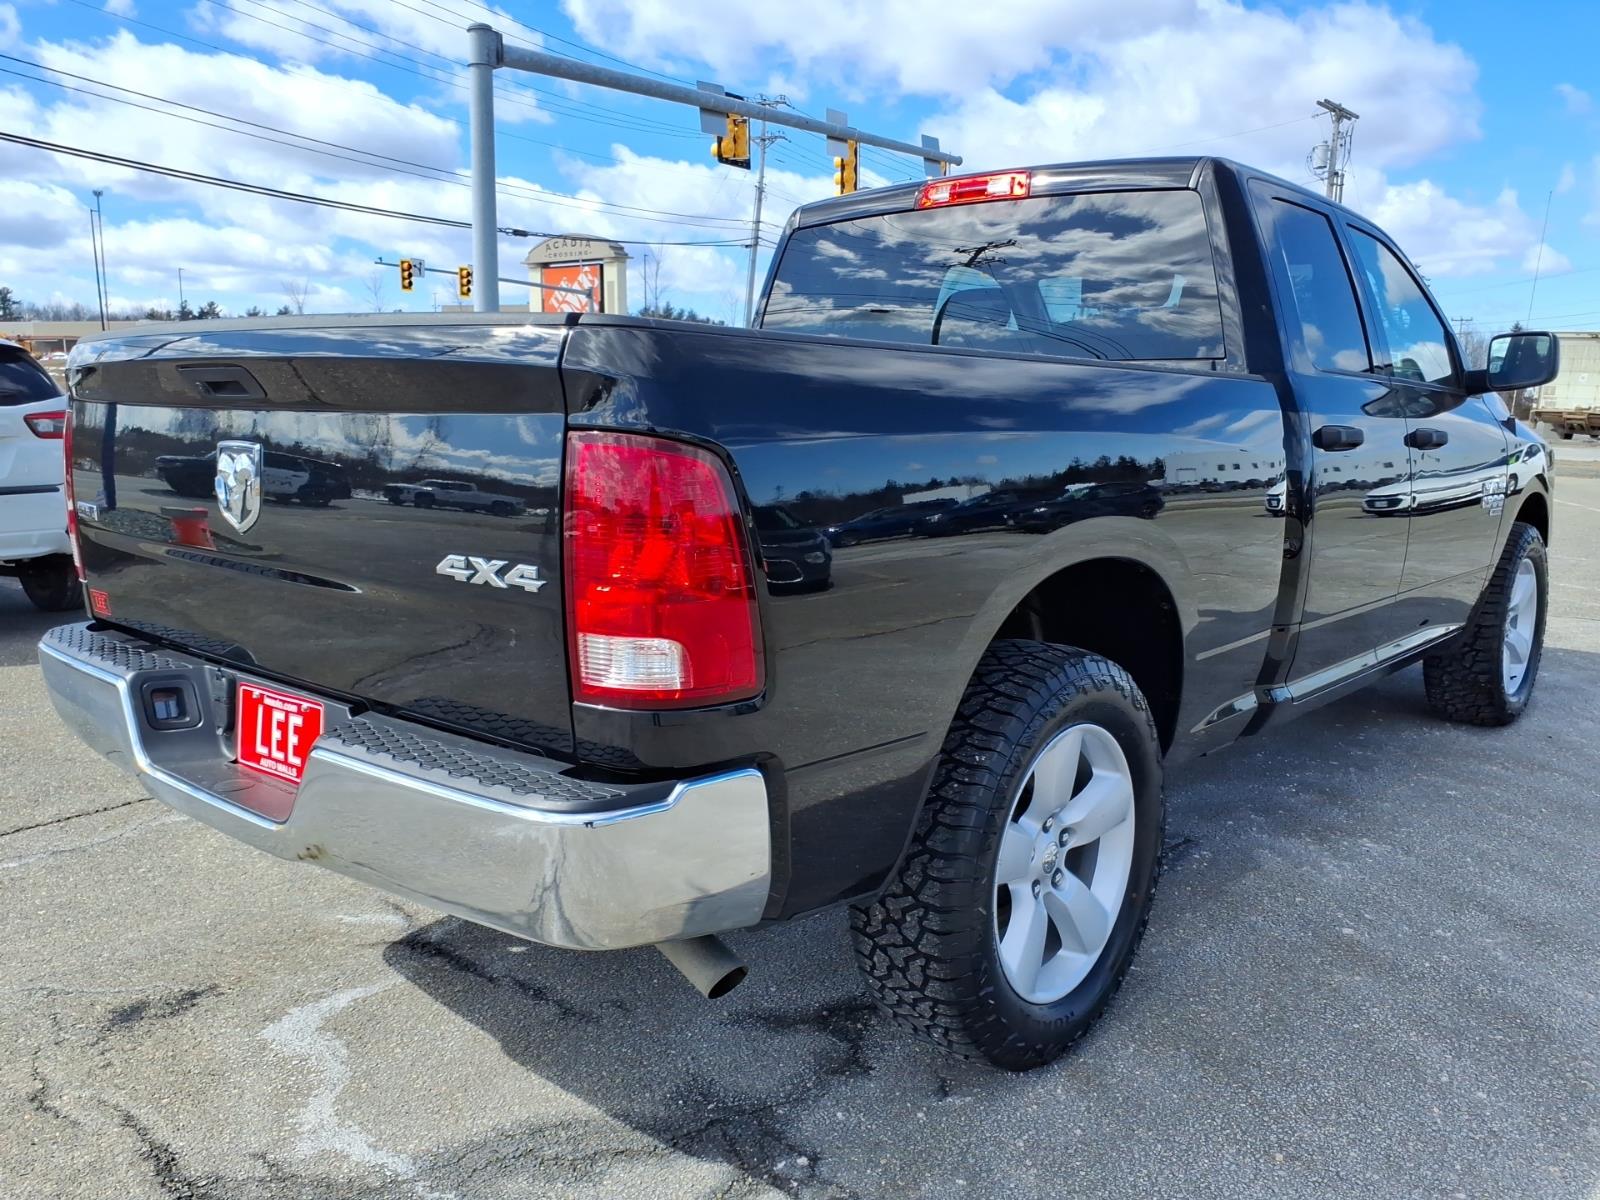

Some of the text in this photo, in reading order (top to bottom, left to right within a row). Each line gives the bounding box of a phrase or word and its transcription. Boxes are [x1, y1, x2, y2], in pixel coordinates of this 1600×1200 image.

[545, 240, 592, 252] ACADIA
[255, 704, 304, 767] LEE
[259, 757, 277, 770] AUTO
